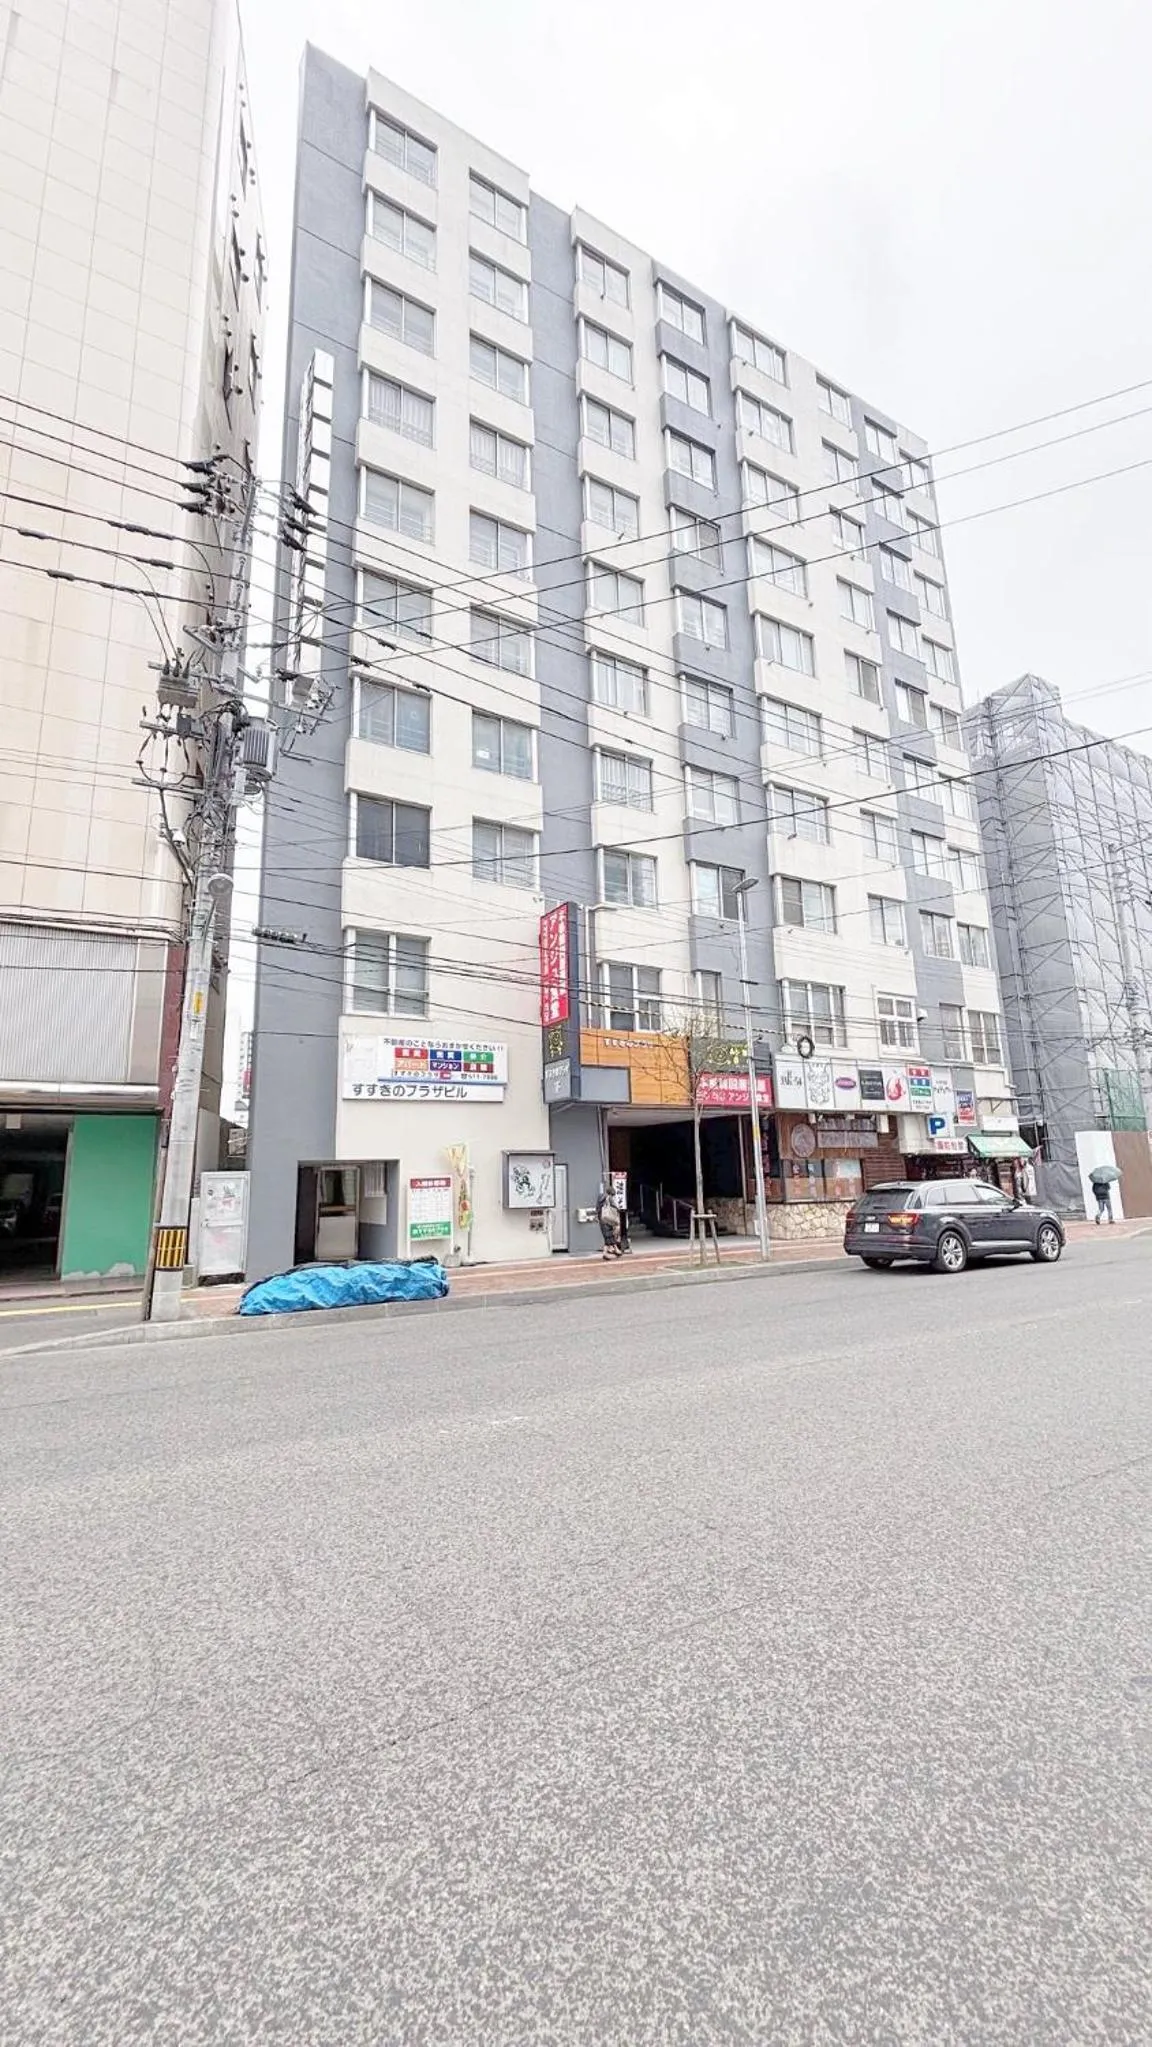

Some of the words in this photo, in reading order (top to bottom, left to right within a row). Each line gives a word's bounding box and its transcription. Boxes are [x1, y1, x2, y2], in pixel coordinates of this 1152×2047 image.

[352, 1084, 468, 1098] すすきのプラザビル
[930, 1117, 946, 1135] P
